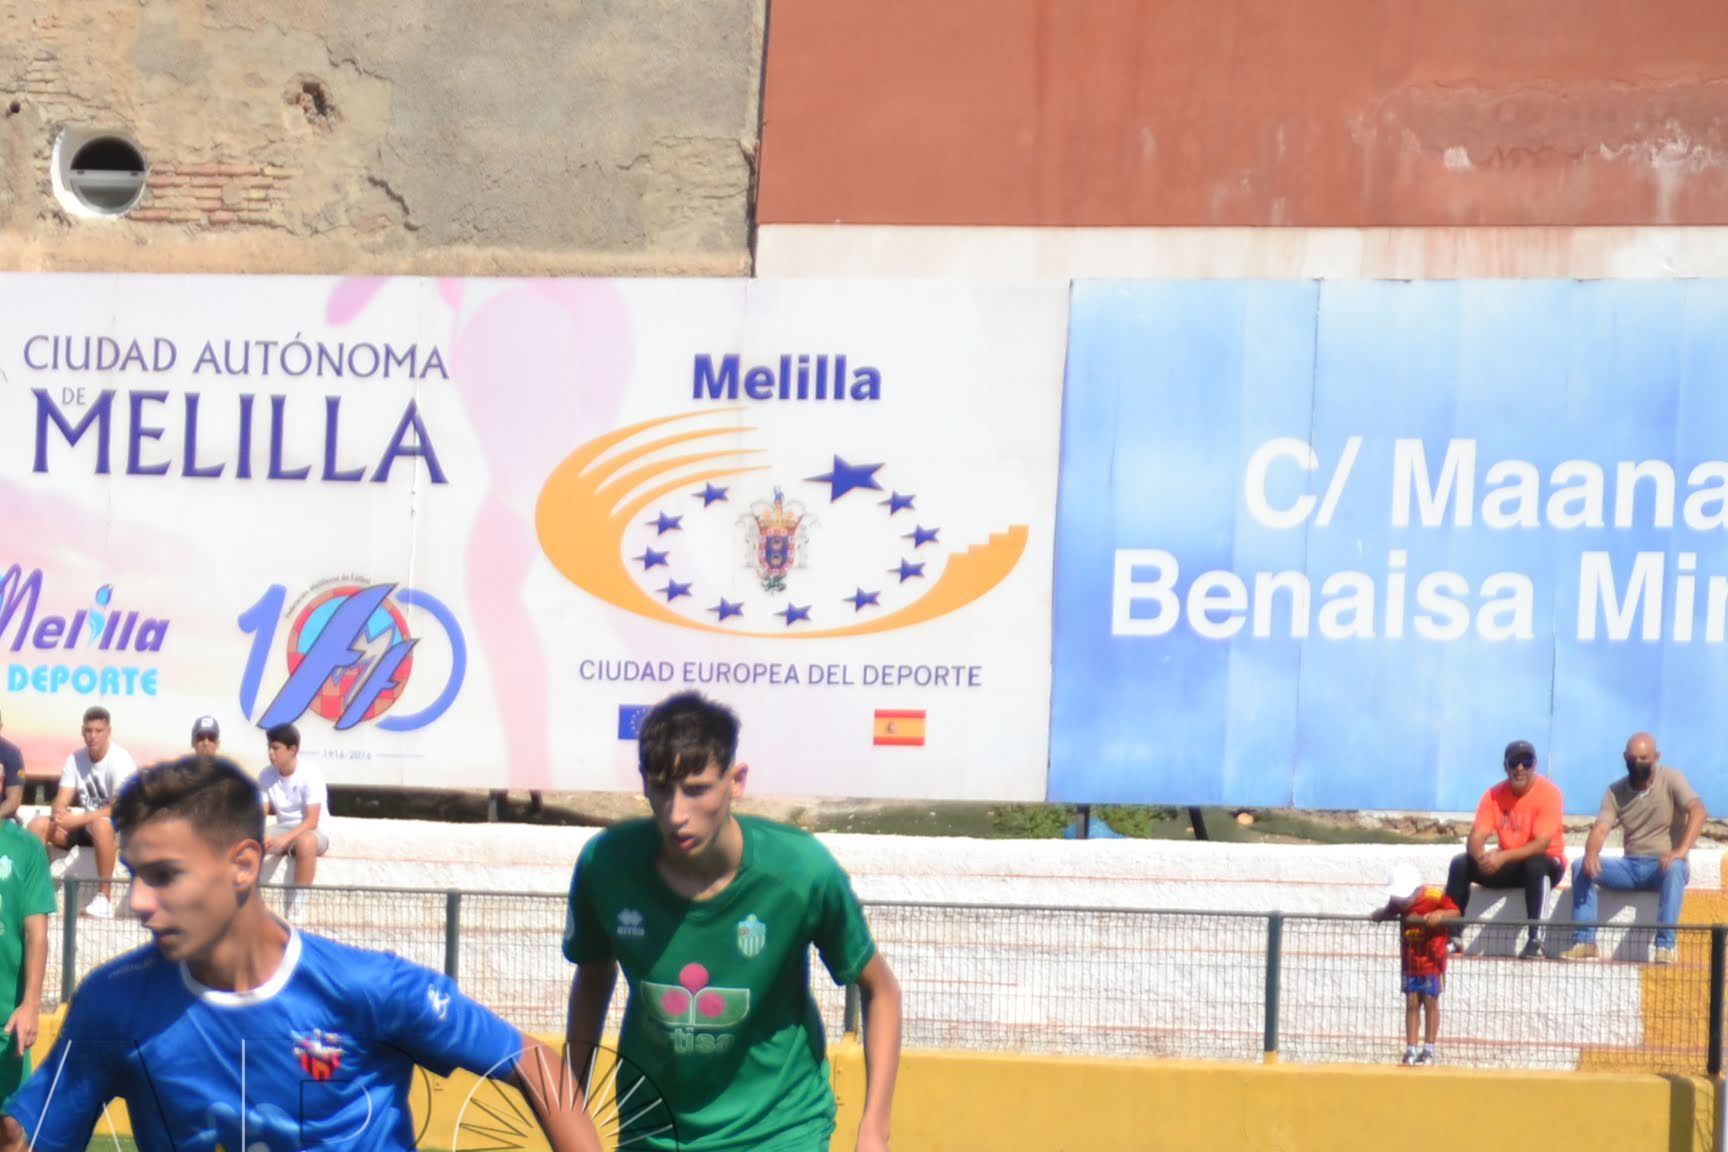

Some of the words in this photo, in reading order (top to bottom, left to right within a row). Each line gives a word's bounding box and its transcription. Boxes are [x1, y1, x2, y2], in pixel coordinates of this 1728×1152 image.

[23, 335, 177, 374] CIUDAD
[193, 332, 450, 380] AUTÓNOMA
[692, 353, 882, 401] Melilla
[61, 386, 87, 406] DE
[31, 388, 450, 485] MELILLA
[1244, 435, 1363, 530] C/
[1111, 548, 1536, 640] Benaisa
[7, 663, 159, 697] DEPORTE
[579, 659, 675, 683] CIUDAD
[682, 661, 800, 685] EUROPEA
[808, 664, 855, 686] DEL
[862, 664, 983, 688] DEPORTE
